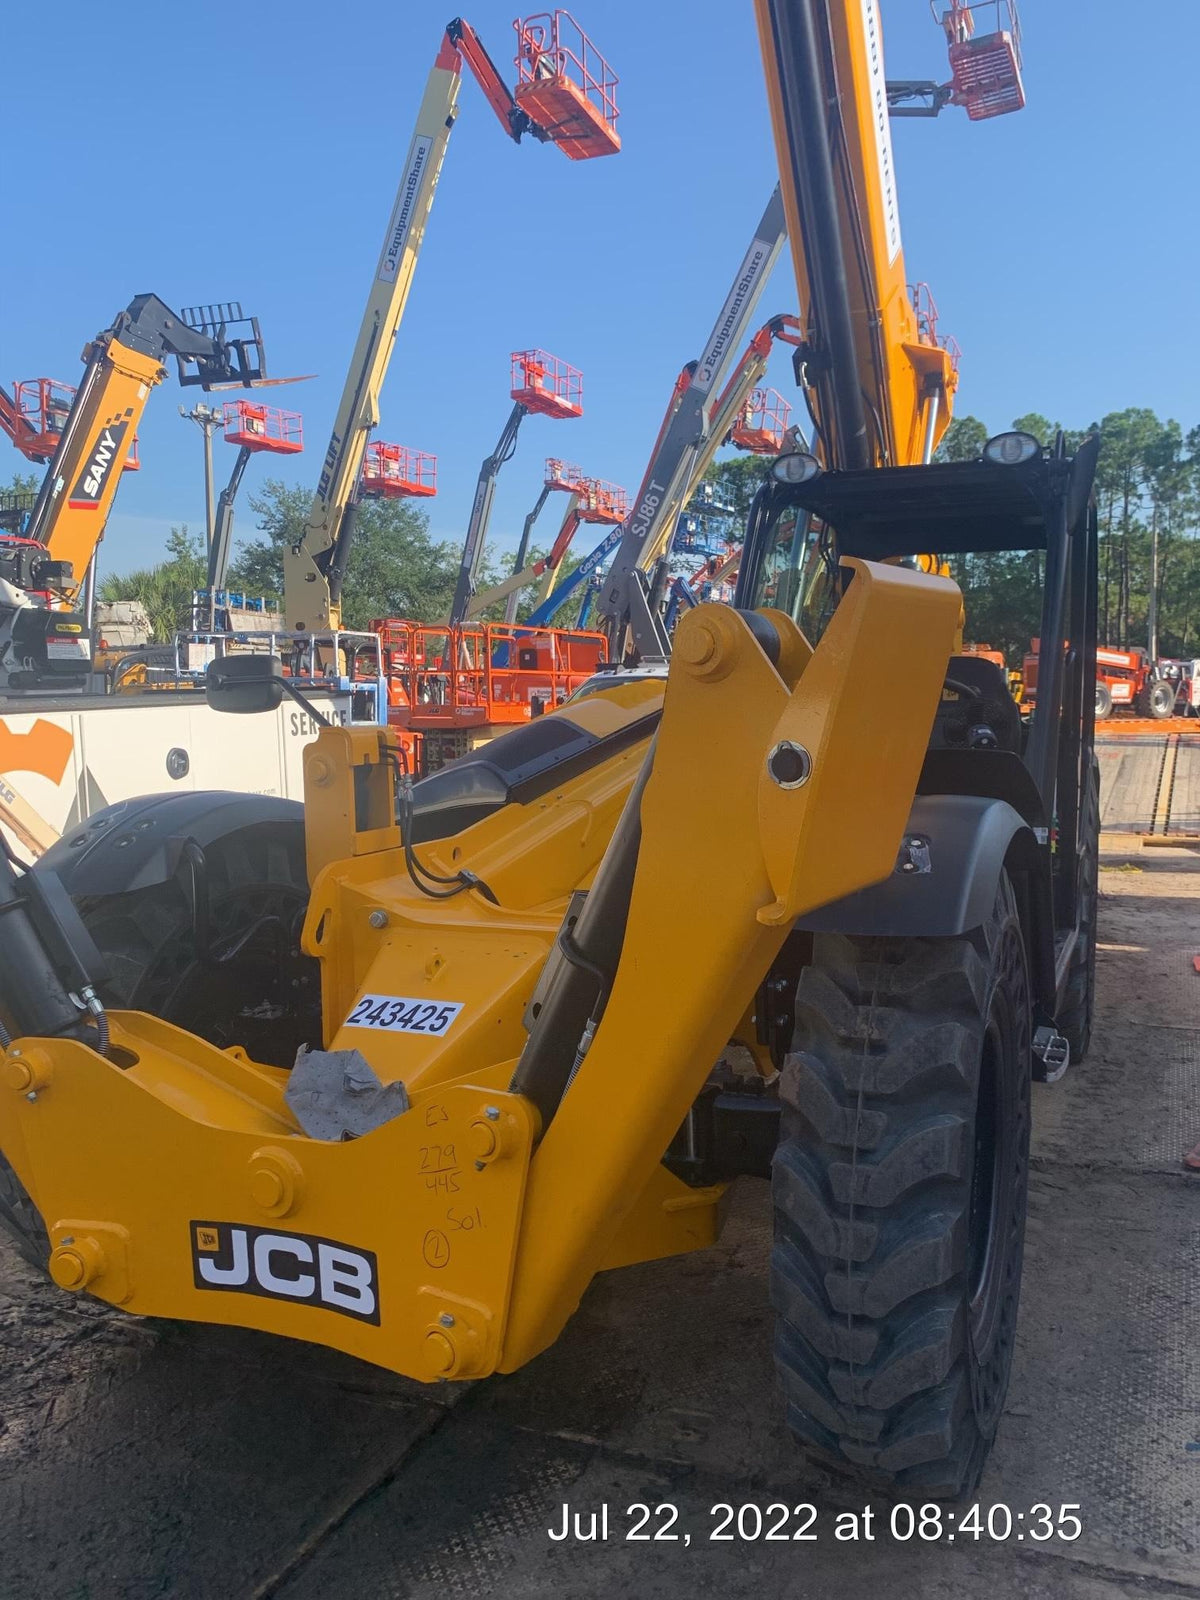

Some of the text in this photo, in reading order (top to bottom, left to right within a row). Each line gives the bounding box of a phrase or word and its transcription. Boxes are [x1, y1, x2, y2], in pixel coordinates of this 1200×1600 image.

[387, 146, 426, 258] EquipmentShare
[704, 250, 764, 368] EquipmentShare
[83, 429, 117, 498] SANY
[324, 431, 341, 470] LIFT
[631, 493, 660, 538] SJ86
[579, 550, 604, 575] Genie
[346, 998, 457, 1032] 243425
[419, 1144, 457, 1170] 279
[425, 1171, 463, 1197] 445
[198, 1229, 375, 1315] JCB
